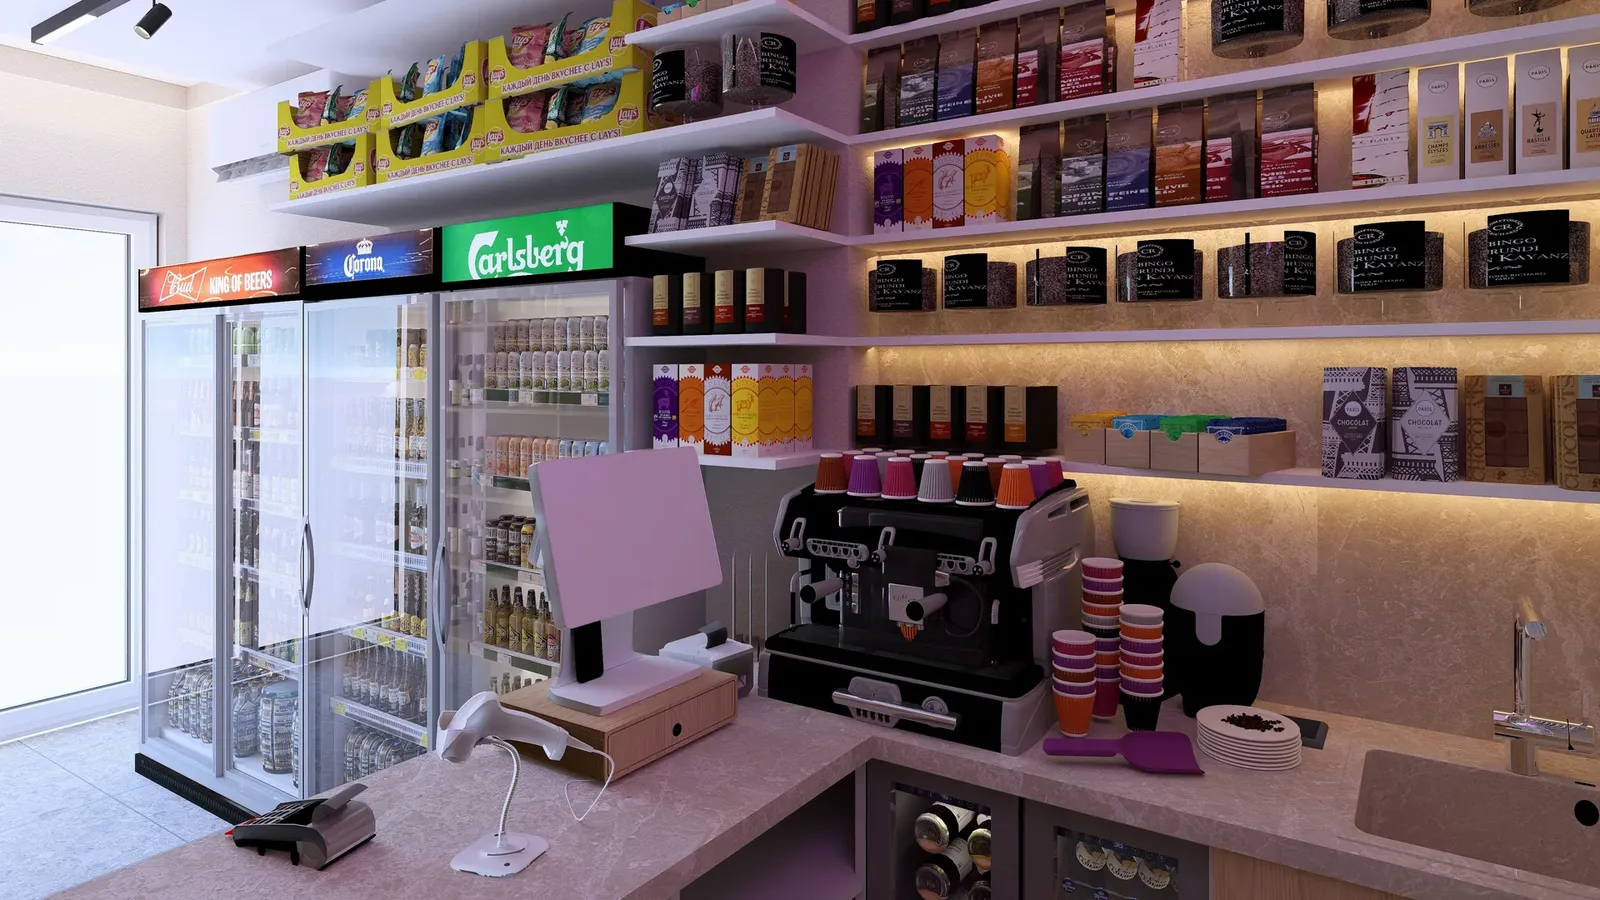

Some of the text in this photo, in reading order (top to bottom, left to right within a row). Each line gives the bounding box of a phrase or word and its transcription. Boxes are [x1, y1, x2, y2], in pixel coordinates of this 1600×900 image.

[762, 58, 789, 66] RUNDI
[502, 78, 532, 92] КАЖДЫЙ
[533, 74, 550, 84] ДЕНЬ
[552, 66, 582, 80] ВКУСНЕЕ
[592, 58, 612, 70] LAY'S!
[390, 112, 410, 123] КАЖДЫЙ
[411, 107, 422, 118] ДЕНЬ
[423, 102, 444, 113] ВКУСНЕЕ
[288, 136, 309, 146] КАЖДЫЙ
[310, 134, 324, 143] ДЕНЬ
[324, 130, 347, 140] ВКУСНЕЕ
[500, 144, 532, 155] КАЖДЫЙ
[535, 141, 553, 150] ДЕНЬ
[555, 136, 588, 149] ВКУСНЕЕ
[598, 130, 621, 141] LAY'S!
[387, 168, 410, 178] КАЖДЫЙ
[411, 165, 425, 175] ДЕНЬ
[426, 161, 450, 171] ВКУСНЕЕ
[1489, 237, 1537, 246] BINGO
[468, 230, 584, 280] Carlsberg
[1354, 246, 1396, 255] BINGO
[1354, 254, 1399, 262] RUNDI
[1488, 246, 1540, 255] RUNDI
[1500, 253, 1568, 262] KAYANZ
[344, 252, 384, 279] Corona
[1364, 260, 1425, 269] KAYANZ
[168, 274, 194, 295] Bud
[210, 270, 272, 294] KING OF BEERS
